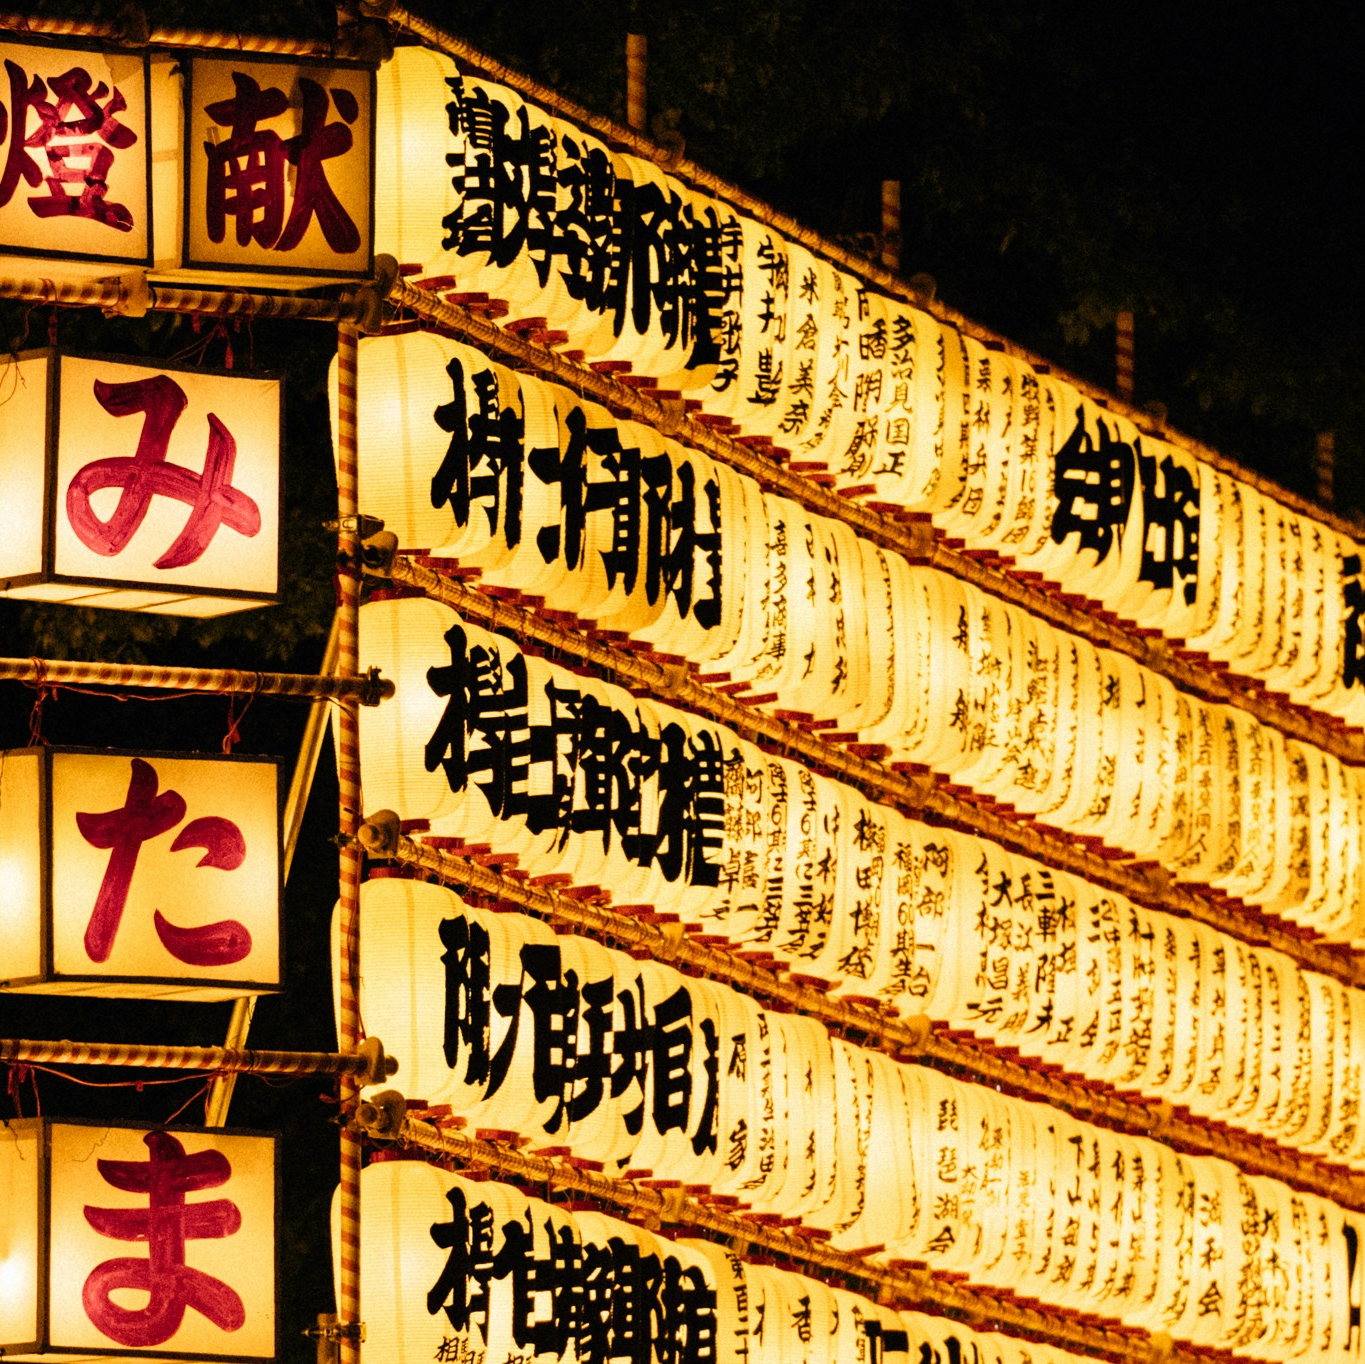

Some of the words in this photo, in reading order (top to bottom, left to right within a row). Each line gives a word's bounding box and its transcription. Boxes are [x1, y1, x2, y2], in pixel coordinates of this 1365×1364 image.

[204, 72, 360, 253] 献
[67, 375, 261, 570] み
[873, 314, 916, 477] 多治見国正
[77, 758, 253, 967] た
[82, 1131, 245, 1347] ま
